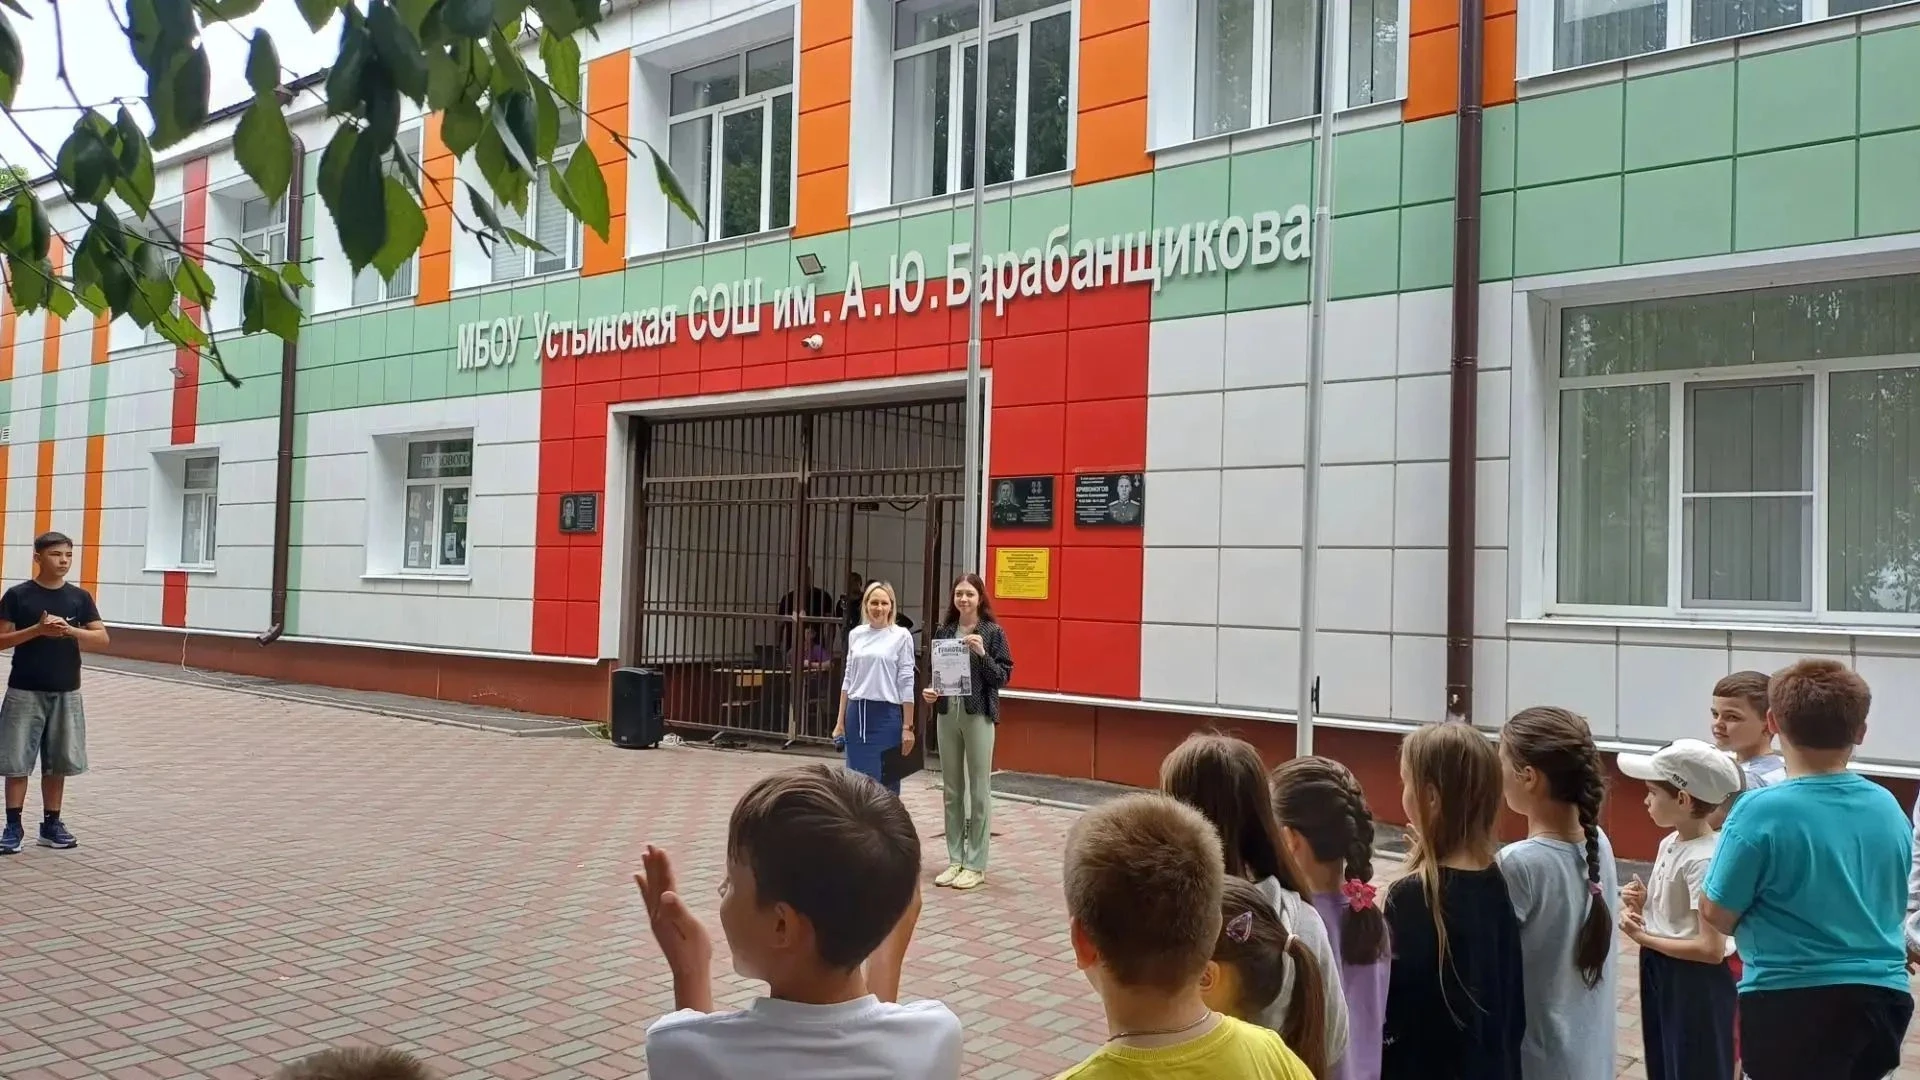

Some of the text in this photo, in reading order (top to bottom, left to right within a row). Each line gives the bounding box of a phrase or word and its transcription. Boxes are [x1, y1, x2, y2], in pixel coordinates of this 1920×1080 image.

[457, 315, 523, 369] МБОУ
[533, 304, 677, 360] Устьинская
[688, 277, 761, 341] СОШ
[773, 283, 831, 330] им.
[946, 203, 1311, 316] Барабанщикова
[1672, 773, 1688, 788] 1978
